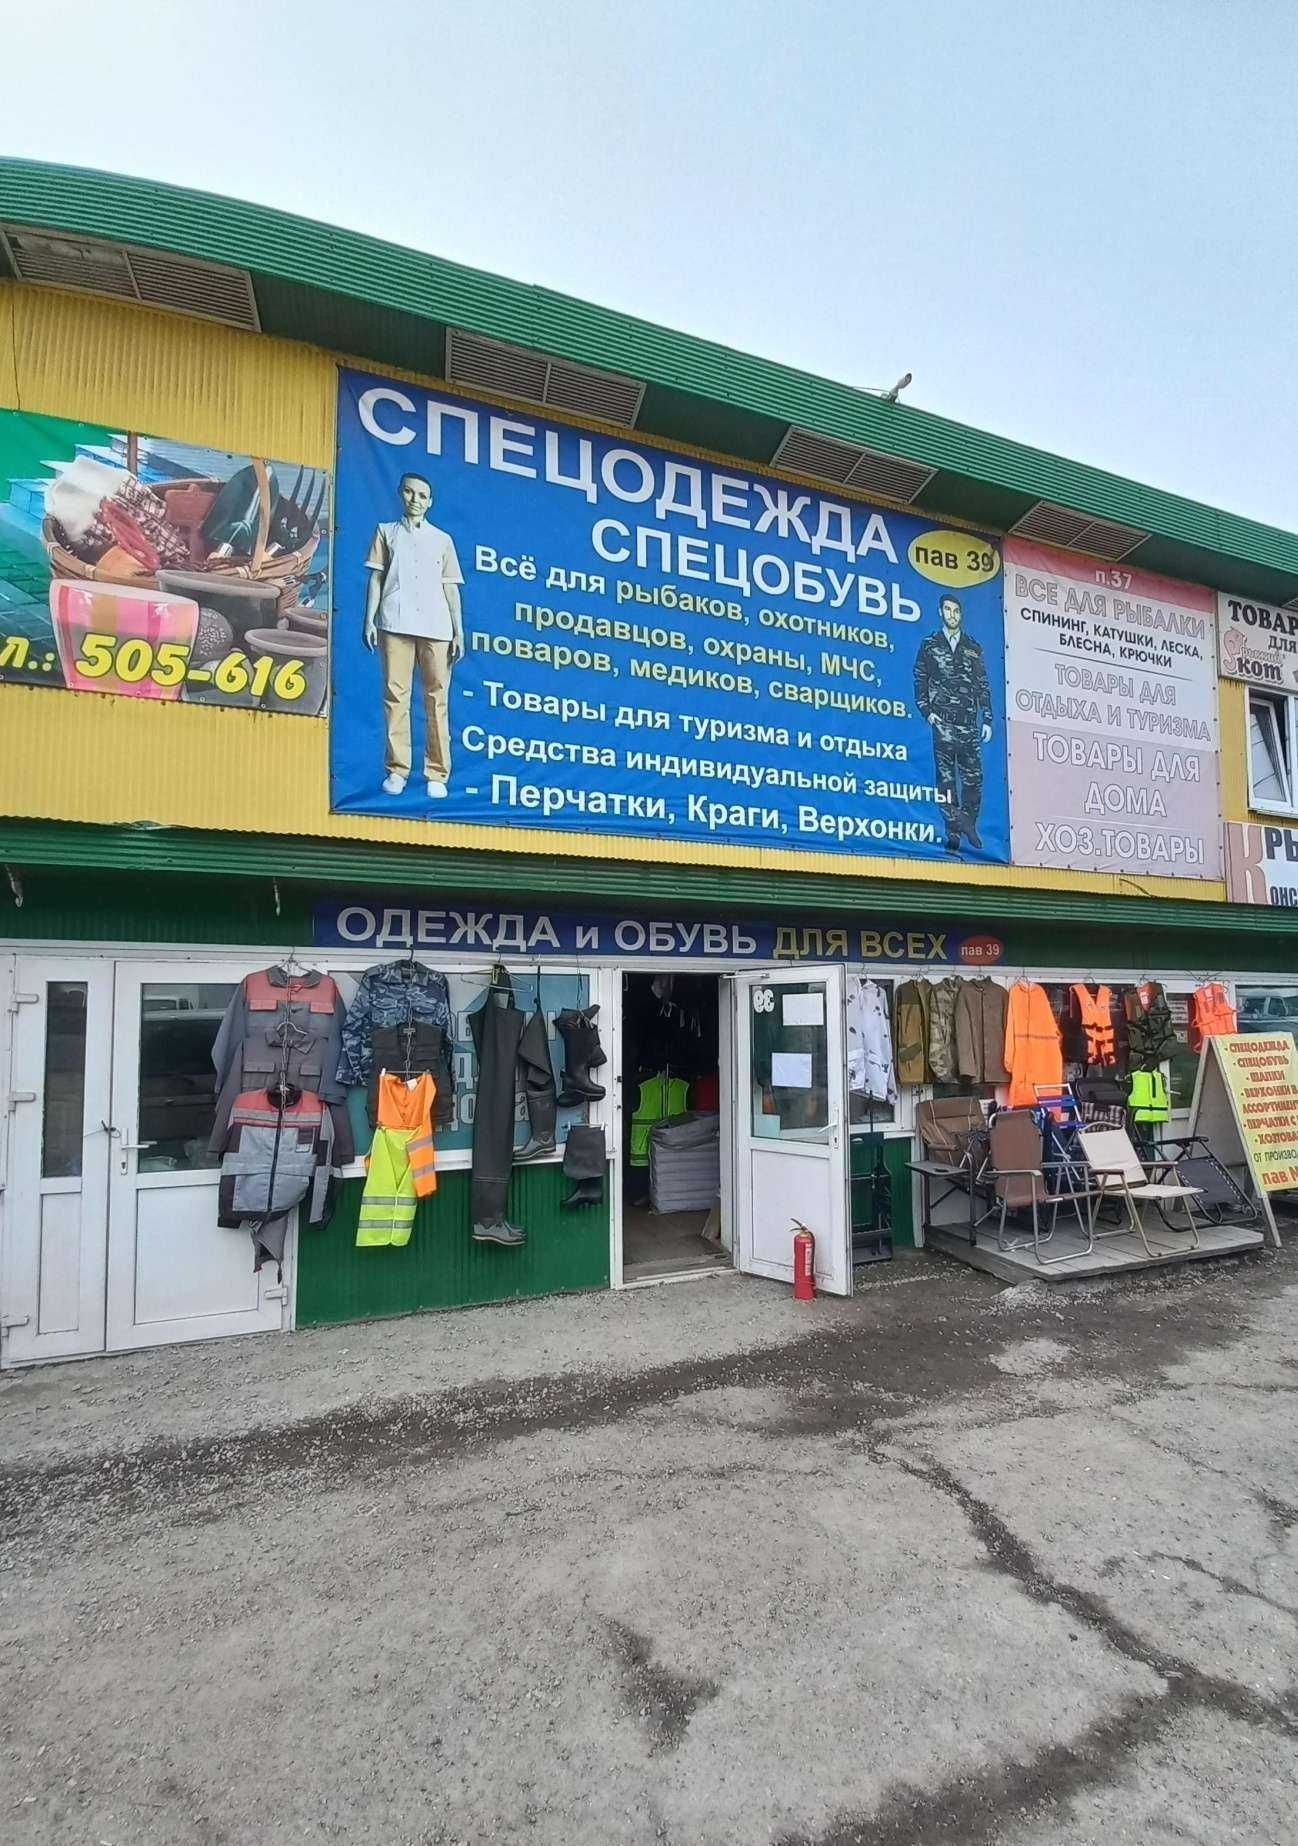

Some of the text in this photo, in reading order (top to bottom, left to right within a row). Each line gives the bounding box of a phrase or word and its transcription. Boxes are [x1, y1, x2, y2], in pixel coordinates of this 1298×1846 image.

[358, 388, 899, 564] СПЕЦОДЕЖДА
[591, 518, 921, 622] СПЕЦОБУВЬ
[914, 544, 995, 573] пав 39
[1095, 568, 1134, 590] п.37
[475, 544, 895, 653] Всё для рыбаков, охотников,
[1015, 573, 1206, 640] ВСЕ ДЛЯ РЫБАЛКИ
[514, 601, 882, 688] продавцов, охраны, МЧС,
[1020, 607, 1204, 661] СПИНИНГ, КАТУШКИ, ЛЕСКА,
[1059, 632, 1173, 669] БЛЕСНА, КРЮЧКИ
[75, 632, 307, 700] 505-616
[471, 631, 913, 719] поваров, медиков, сварщиков.
[1054, 663, 1177, 707] ТОВАРЫ ДЛЯ
[482, 680, 606, 723] Товары
[614, 705, 671, 731] для
[679, 714, 790, 747] туризма
[798, 731, 812, 749] и
[819, 735, 908, 761] отдыха
[1015, 688, 1212, 741] ОТДЫХА И ТУРИЗМА
[461, 725, 953, 804] Средства индивидуальной защиты
[1033, 731, 1201, 783] ТОВАРЫ ДЛЯ
[491, 774, 676, 825] Перчатки,
[687, 793, 788, 835] Краги,
[798, 805, 943, 844] Верхонки.
[1084, 781, 1168, 818] ДОМА
[1034, 821, 1205, 865] ХОЗ.ТОВАРЫ
[336, 906, 949, 960] ОДЕЖДА и ОБУВЬ ДЛЯ ВСЕХ
[960, 943, 1000, 957] пав 39
[1229, 1040, 1290, 1053] СПЕЦОДЕЖДА
[1237, 1055, 1290, 1068] СПЕЦОБУВЬ
[1250, 1071, 1285, 1082] ШАПКИ
[1262, 1171, 1288, 1185] пав
